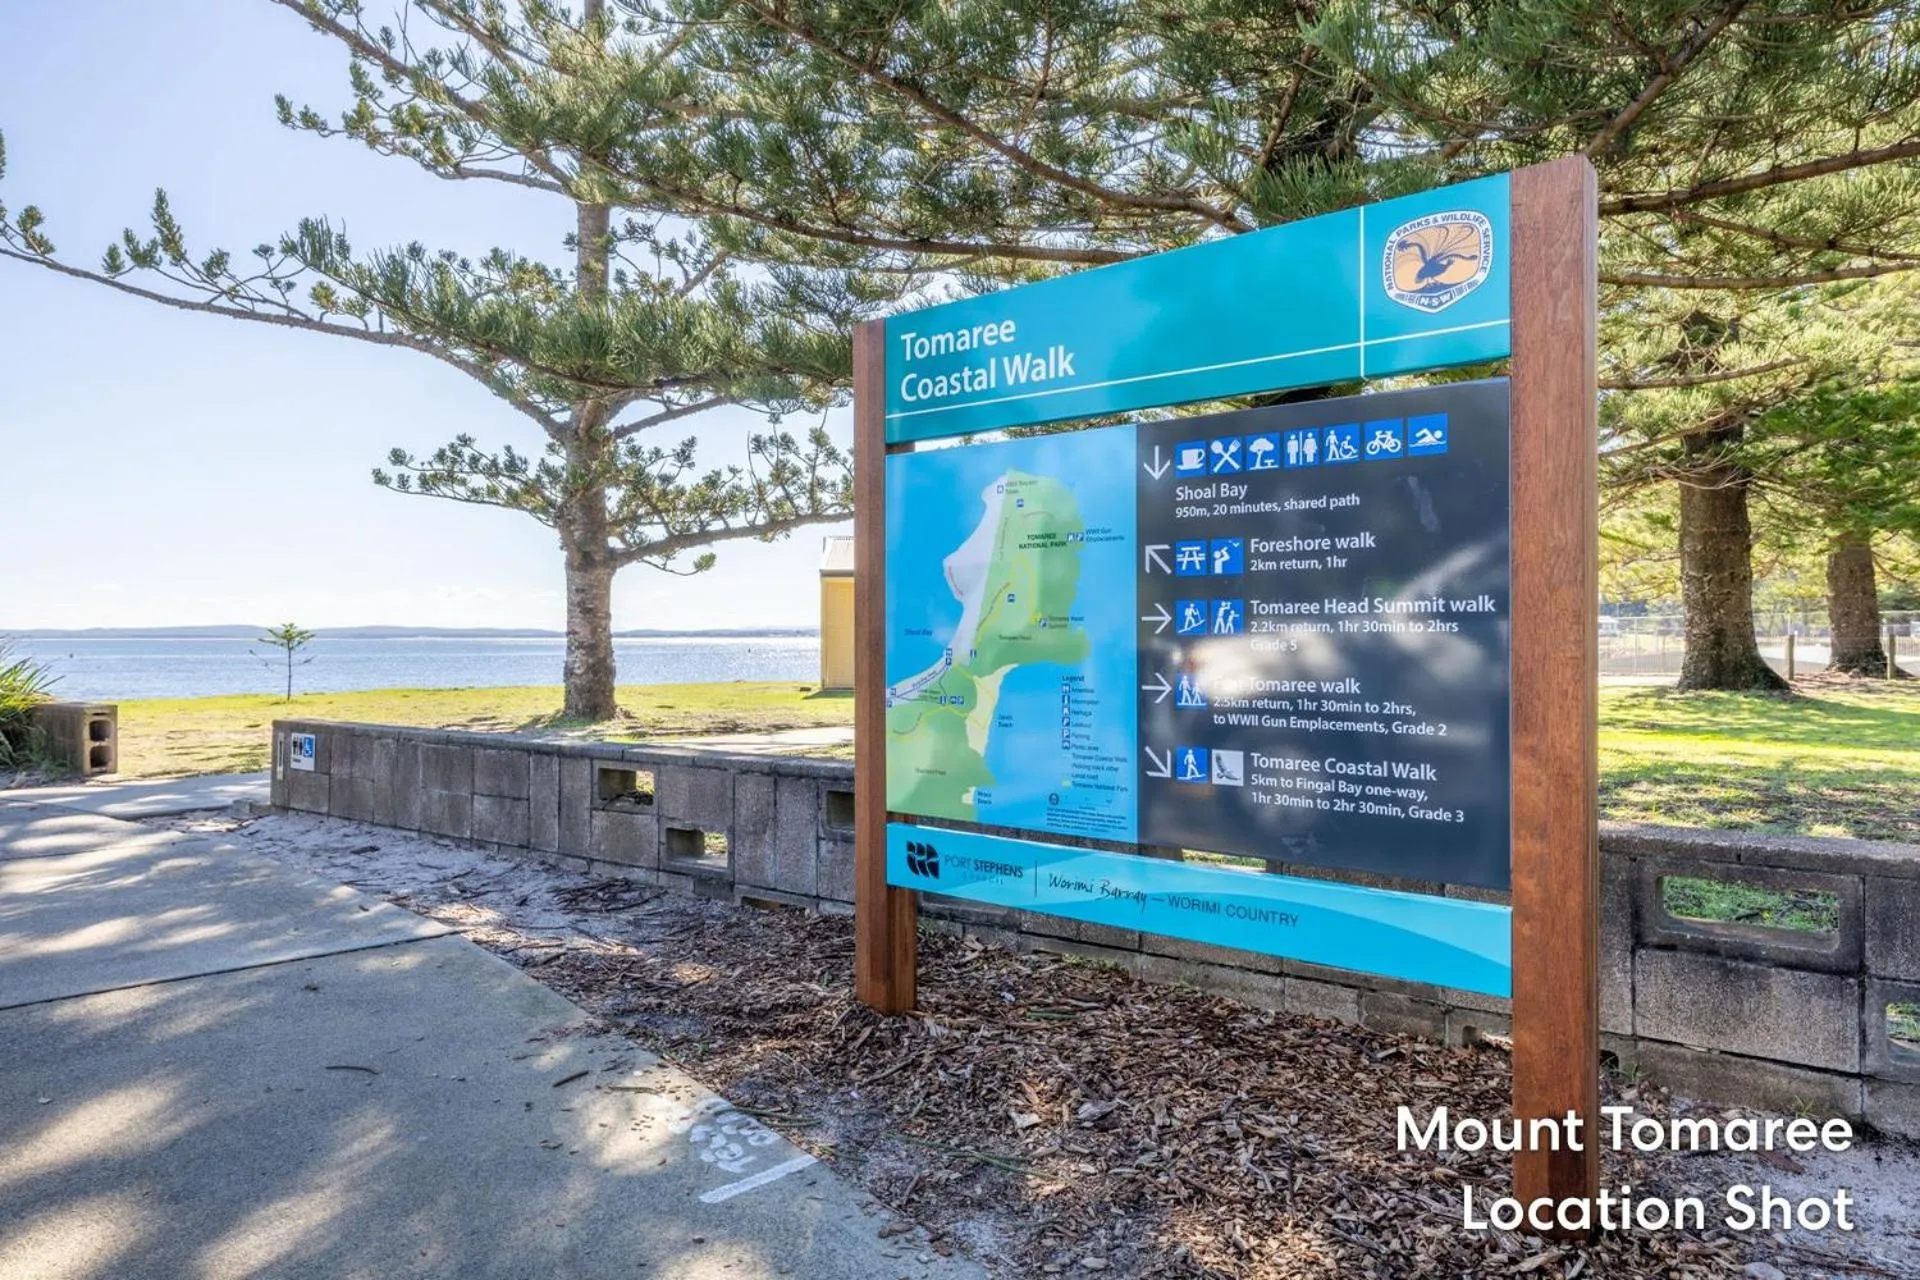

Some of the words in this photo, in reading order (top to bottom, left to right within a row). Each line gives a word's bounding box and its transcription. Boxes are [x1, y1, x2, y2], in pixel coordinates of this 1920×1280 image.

[1396, 218, 1430, 237] PARKS
[1440, 212, 1486, 227] WILDLIFE
[1479, 227, 1491, 273] SERVICE
[900, 319, 1016, 361] Tomaree
[900, 358, 996, 402] Coastal
[1003, 345, 1076, 386] Walk
[1175, 484, 1217, 501] Shoal
[1220, 482, 1248, 500] Bay
[1175, 505, 1210, 519] 950m,
[1213, 503, 1227, 516] 20
[1229, 500, 1281, 514] minutes,
[1284, 496, 1326, 510] shared
[1329, 494, 1361, 509] path
[1250, 535, 1331, 553] Foreshore
[1335, 532, 1377, 549] walk
[1250, 558, 1277, 572] 2km
[1279, 557, 1323, 571] return,
[1325, 556, 1348, 569] 1hr
[1250, 600, 1320, 616] Tomaree
[1324, 598, 1369, 614] Head
[1373, 596, 1446, 614] Summit
[1448, 596, 1496, 613] walk
[1250, 621, 1289, 634] 2.2km
[1291, 621, 1335, 635] return,
[1337, 620, 1359, 633] 1hr
[1362, 620, 1405, 633] 30min
[1408, 621, 1423, 633] to
[1426, 619, 1459, 633] 2hrs
[1250, 638, 1287, 651] Grade
[1289, 638, 1298, 651] 5
[1248, 677, 1317, 693] Tomaree
[1320, 678, 1361, 694] walk
[1213, 696, 1249, 708] 2.5km
[1252, 697, 1294, 712] return,
[1296, 698, 1318, 711] 1hr
[1320, 699, 1362, 713] 30min
[1365, 701, 1379, 714] to
[1382, 702, 1417, 716] 2hrs,
[1213, 713, 1226, 725] to
[1227, 713, 1259, 726] WWII
[1261, 715, 1287, 728] Gun
[1289, 717, 1389, 735] Emplacements,
[1392, 720, 1435, 735] Grade
[1438, 723, 1447, 736] 2
[1250, 753, 1321, 773] Tomaree
[1324, 757, 1388, 778] Coastal
[1392, 763, 1438, 781] Walk
[1251, 775, 1278, 788] 5km
[1280, 777, 1293, 788] to
[1296, 777, 1336, 794] Fingal
[1338, 780, 1362, 796] Bay
[1365, 784, 1429, 801] one-way,
[1251, 791, 1272, 805] 1hr
[1274, 793, 1314, 809] 30min
[1317, 798, 1330, 810] to
[1333, 799, 1355, 812] 2hr
[1358, 801, 1406, 818] 30min,
[1409, 806, 1452, 822] Grade
[1455, 809, 1464, 823] 3
[944, 854, 972, 868] PORT
[974, 859, 1024, 878] STEPHENS
[1048, 873, 1095, 893] Worimi
[1167, 894, 1221, 915] WORIMI
[1224, 903, 1299, 928] COUNTRY
